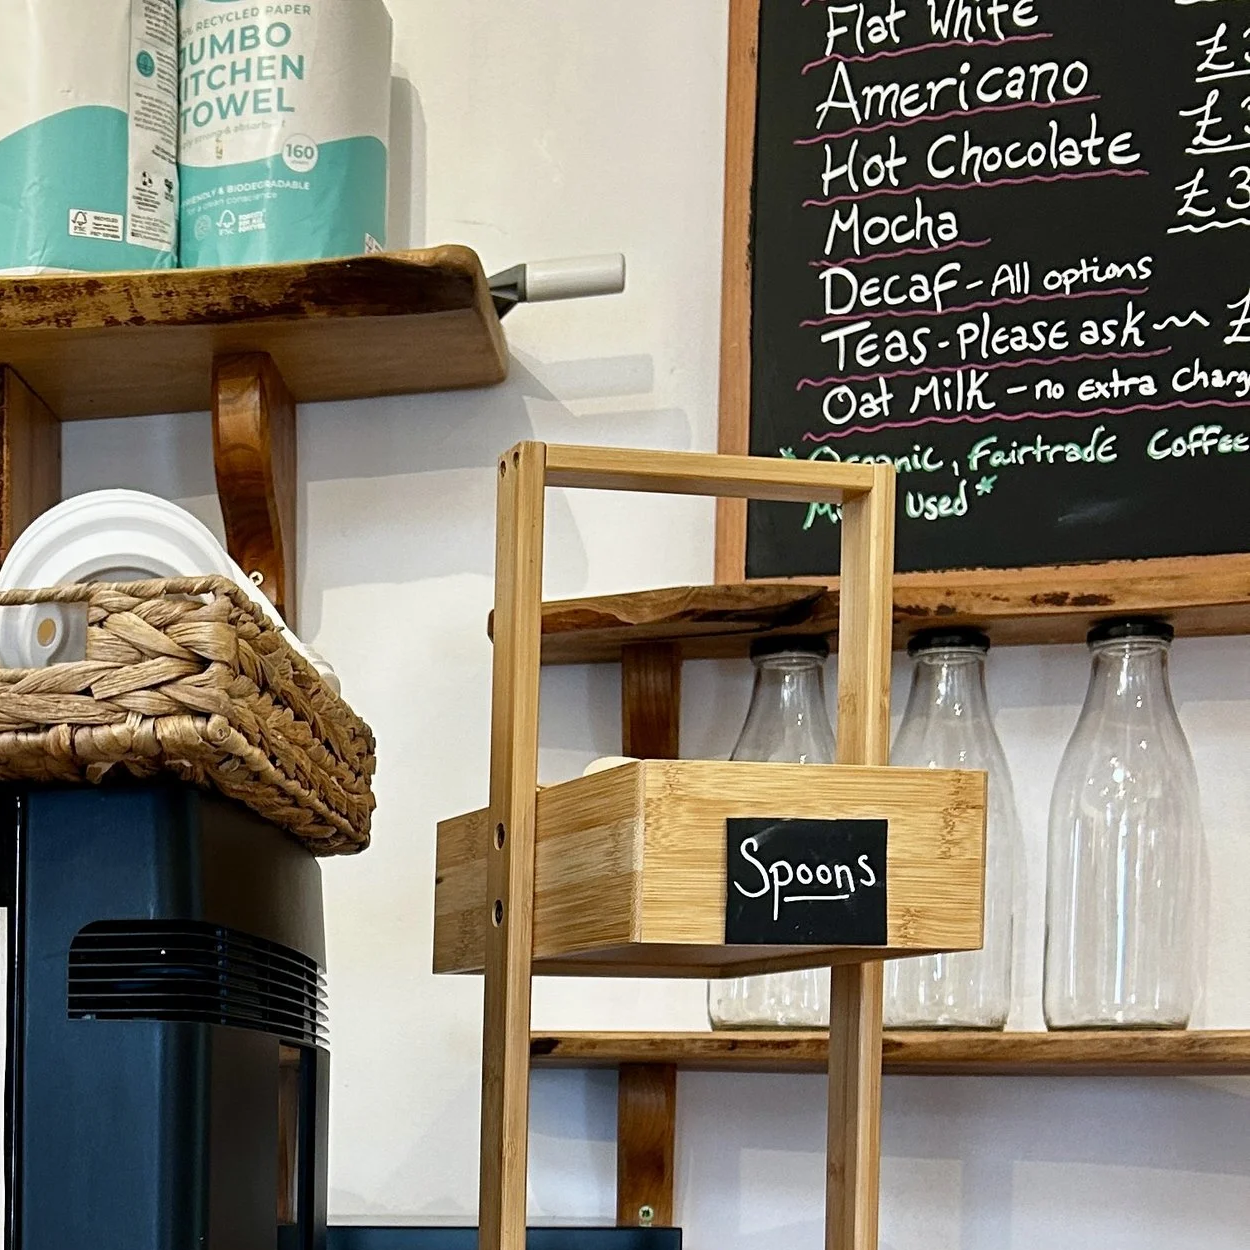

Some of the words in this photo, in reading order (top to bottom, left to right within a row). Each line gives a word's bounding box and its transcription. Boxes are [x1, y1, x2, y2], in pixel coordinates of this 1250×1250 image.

[196, 7, 260, 32] RECYCLED
[265, 4, 312, 15] PAPER
[825, 0, 906, 56] Flat
[927, 0, 1039, 42] White
[180, 22, 292, 74] JUMBO
[183, 54, 305, 101] ITCHEN
[816, 61, 1088, 129] Americano
[180, 87, 295, 134] TOWEL
[286, 143, 315, 159] 160
[822, 136, 907, 196] Hot
[927, 112, 1141, 184] Chocolate
[824, 197, 958, 255] Mocha
[819, 262, 961, 315] Decaf
[991, 262, 1029, 296] All
[1043, 256, 1152, 295] options
[821, 321, 930, 371] Teas
[1080, 301, 1145, 347] ask
[823, 377, 894, 424] Oat
[1035, 379, 1064, 400] no
[967, 425, 1118, 471] Fairtrade
[1147, 425, 1250, 460] Coffee
[733, 837, 876, 920] Spoons
